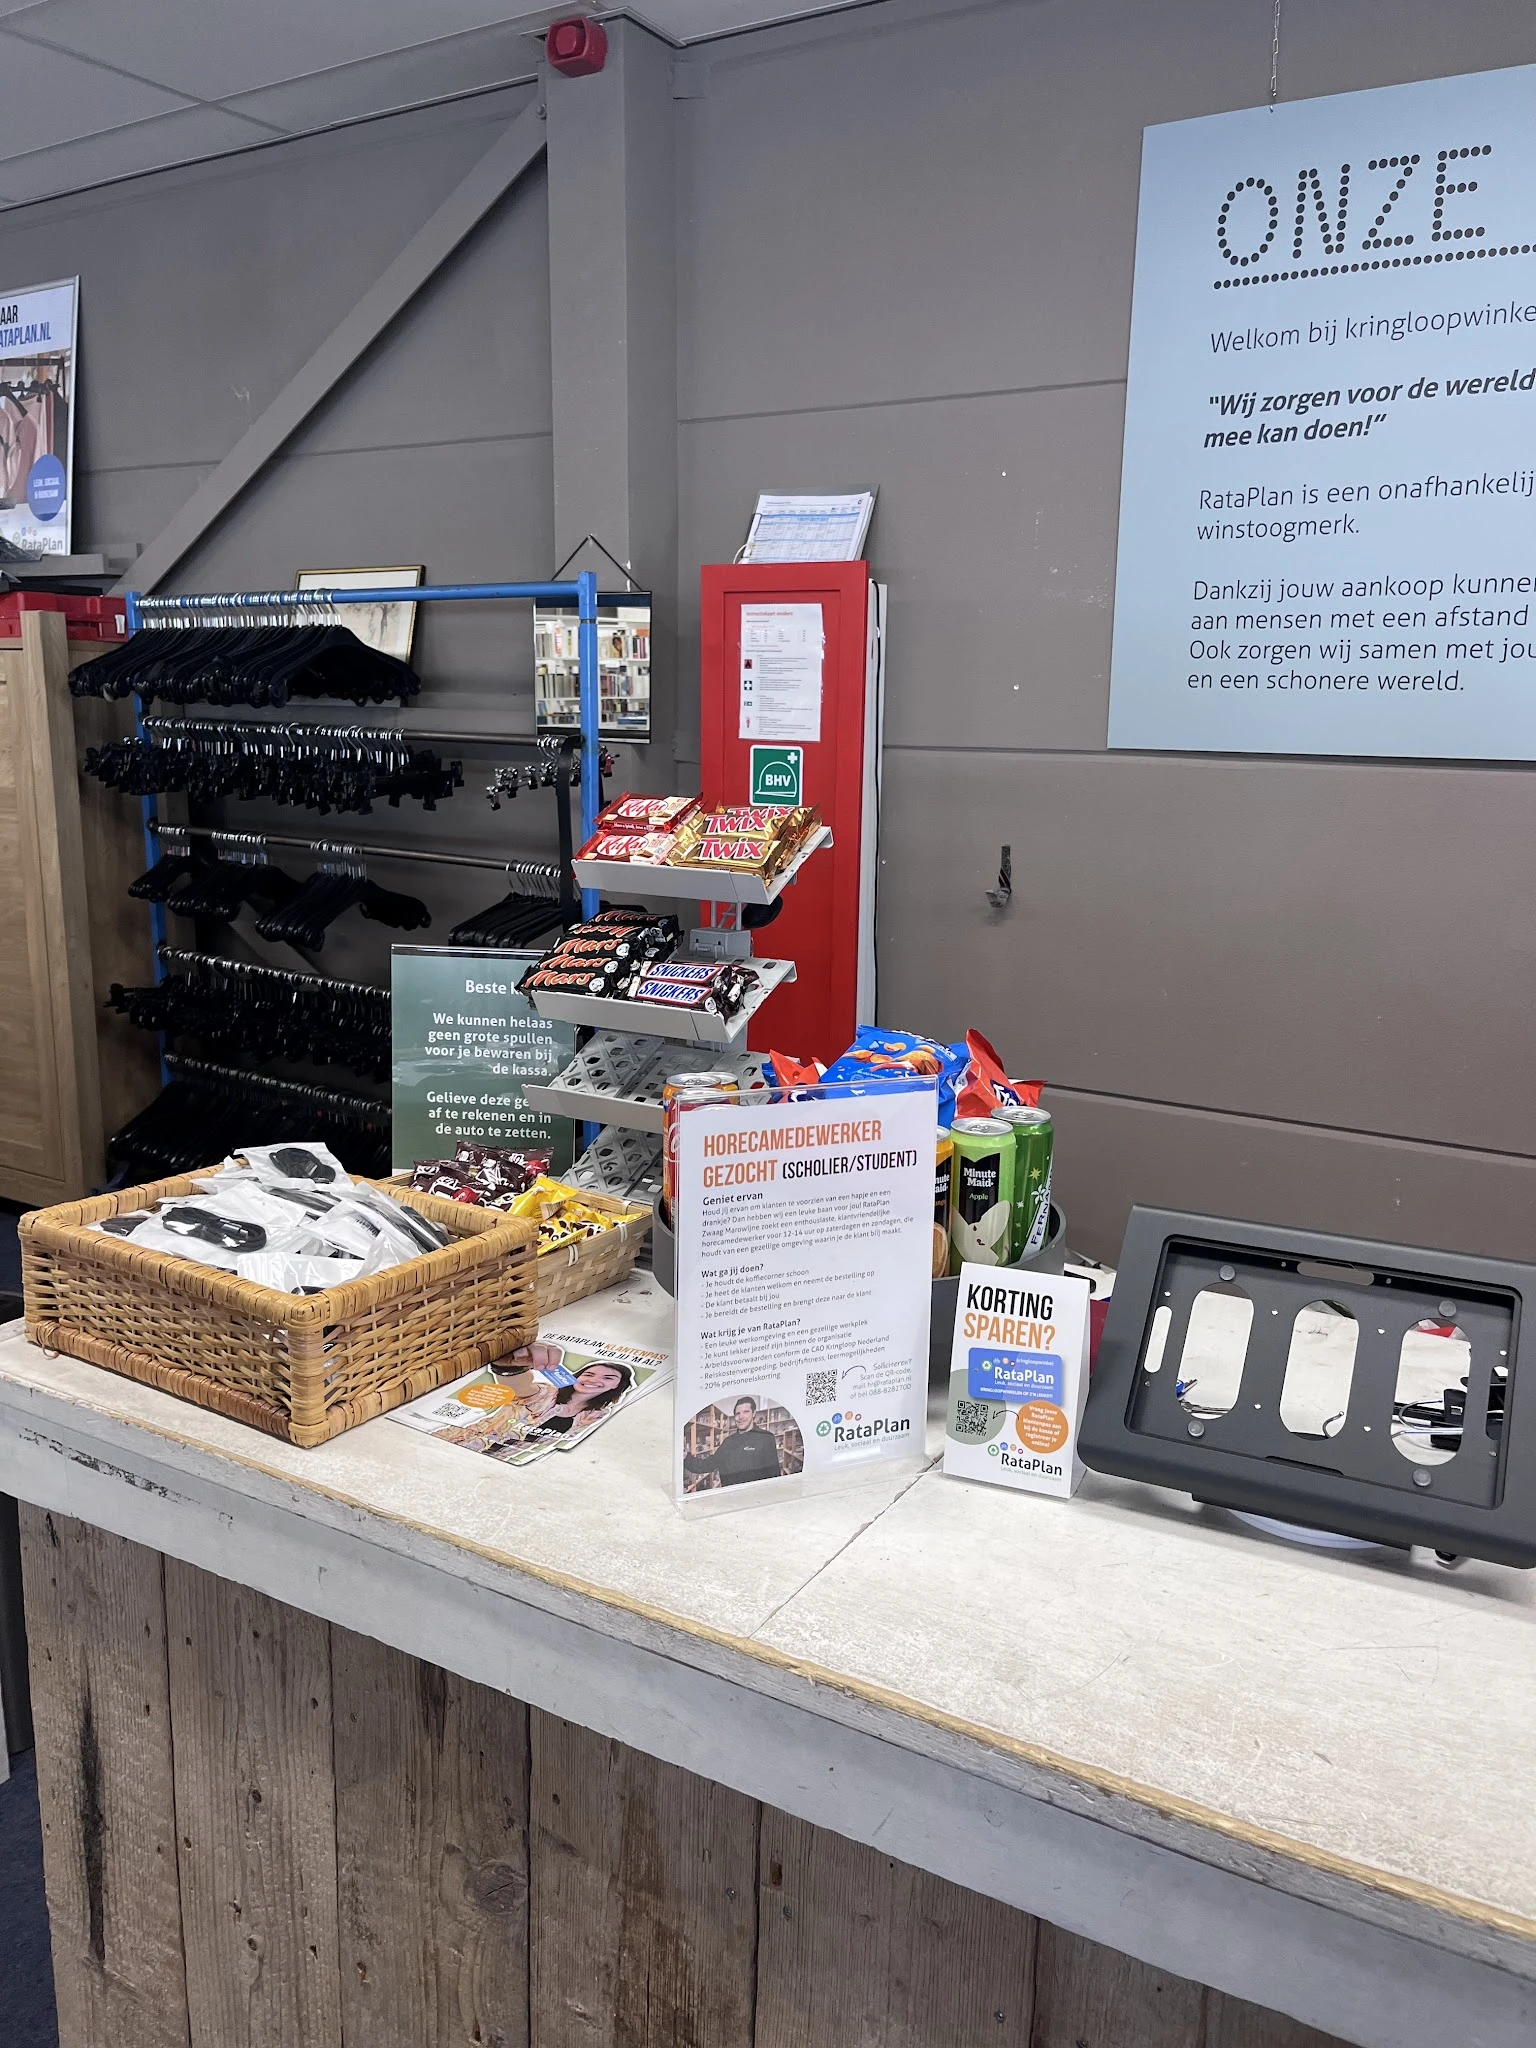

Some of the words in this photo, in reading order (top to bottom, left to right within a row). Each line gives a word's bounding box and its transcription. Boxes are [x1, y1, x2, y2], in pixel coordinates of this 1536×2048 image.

[1217, 145, 1491, 267] ONZE
[0, 304, 18, 325] AAR
[0, 321, 51, 347] ATAPLAN.NL
[1210, 330, 1300, 353] Welkom
[1308, 320, 1337, 346] bij
[1345, 301, 1536, 341] kringloopwinke
[1260, 387, 1341, 415] zorgen
[1348, 383, 1402, 405] voor
[1407, 377, 1438, 399] de
[1445, 368, 1536, 396] wereld
[1204, 426, 1251, 448] mee
[1256, 424, 1298, 444] kan
[1199, 484, 1293, 510] RataPlan
[1301, 483, 1318, 504] is
[1327, 482, 1370, 503] een
[1378, 470, 1536, 501] onafhankelij
[1197, 513, 1360, 543] winstoogmerk.
[1193, 579, 1271, 603] Dankzij
[1277, 580, 1334, 603] jouw
[1342, 575, 1443, 601] aankoop
[1453, 572, 1536, 595] kunne
[1191, 612, 1228, 630] aan
[1236, 609, 1322, 630] mensen
[1331, 608, 1375, 629] met
[1382, 607, 1427, 628] een
[1435, 604, 1529, 628] afstand
[1189, 639, 1231, 660] Ook
[1238, 642, 1311, 665] zorgen
[1319, 640, 1352, 664] wij
[1359, 640, 1437, 660] samen
[1445, 638, 1495, 660] met
[1188, 672, 1212, 689] en
[1219, 671, 1259, 690] een
[1266, 669, 1369, 691] schonere
[1377, 669, 1465, 692] wereld.
[765, 773, 791, 788] BHV
[554, 938, 623, 954] Mars
[540, 953, 612, 969] Mars
[523, 969, 596, 988] Mars
[649, 964, 716, 979] SNICKERS
[465, 979, 507, 994] Beste
[638, 981, 706, 1001] SNICKERS
[433, 1012, 454, 1024] We
[457, 1013, 506, 1027] kunnen
[510, 1016, 553, 1029] helaas
[428, 1030, 460, 1043] geen
[464, 1032, 500, 1045] grote
[503, 1033, 553, 1047] spullen
[425, 1046, 455, 1057] voor
[457, 1045, 471, 1059] je
[474, 1046, 531, 1060] bewaren
[535, 1049, 552, 1063] bij
[492, 1063, 509, 1075] de
[512, 1063, 552, 1077] kassa.
[426, 1091, 476, 1105] Gelieve
[480, 1093, 511, 1106] deze
[428, 1107, 442, 1119] af
[445, 1108, 458, 1119] te
[462, 1109, 515, 1122] rekenen
[519, 1113, 535, 1123] en
[539, 1112, 551, 1124] in
[435, 1122, 452, 1135] de
[455, 1125, 484, 1136] auto
[488, 1126, 501, 1137] te
[505, 1127, 551, 1139] zetten.
[704, 1120, 882, 1157] HORECAMEDEWERKER
[703, 1159, 778, 1188] GEZOCHT
[935, 1174, 950, 1184] nute
[963, 1167, 997, 1178] Minute
[934, 1183, 948, 1193] aid
[968, 1192, 989, 1201] Apple
[703, 1195, 735, 1206] Geniet
[737, 1192, 763, 1202] ervan
[703, 1208, 720, 1216] Houd
[762, 1202, 787, 1210] klanten
[797, 1197, 824, 1206] voorzien
[851, 1191, 868, 1201] hapje
[879, 1189, 891, 1197] een
[702, 1216, 731, 1227] drankje?
[732, 1215, 746, 1223] Dan
[747, 1213, 772, 1222] hebben
[774, 1211, 783, 1219] wij
[798, 1208, 816, 1216] leuke
[818, 1206, 833, 1214] baan
[863, 1199, 890, 1208] RataPlan
[702, 1228, 723, 1237] Zwaag
[725, 1224, 760, 1234] Marowijne
[761, 1222, 779, 1230] zoekt
[837, 1209, 891, 1221] klantvriendelijke
[701, 1269, 717, 1278] Wat
[718, 1269, 728, 1278] ga
[729, 1266, 738, 1276] jij
[740, 1263, 764, 1274] doen?
[966, 1283, 1054, 1321] KORTING
[700, 1331, 716, 1339] Wat
[718, 1328, 737, 1338] krijg
[738, 1326, 746, 1336] je
[747, 1325, 761, 1333] van
[763, 1318, 801, 1331] RataPlan?
[963, 1312, 1056, 1351] SPAREN?
[557, 1334, 605, 1348] RATAPLAN
[595, 1349, 616, 1357] HEB
[641, 1357, 663, 1367] AL?
[704, 1354, 772, 1369] Arbeidsvoorwaarden
[774, 1350, 801, 1359] conform
[811, 1345, 825, 1353] CAO
[826, 1340, 857, 1351] Kringloop
[858, 1335, 890, 1346] Nederland
[827, 1345, 885, 1360] leermogelijkheden
[704, 1381, 721, 1389] 20%
[722, 1371, 781, 1388] personeelskorting
[994, 1366, 1054, 1384] RataPlan
[514, 1422, 572, 1439] RataPlan
[834, 1417, 910, 1443] RataPlan
[851, 1438, 872, 1448] sociaal
[881, 1432, 910, 1442] duurzaam
[1001, 1453, 1062, 1476] RataPlan
